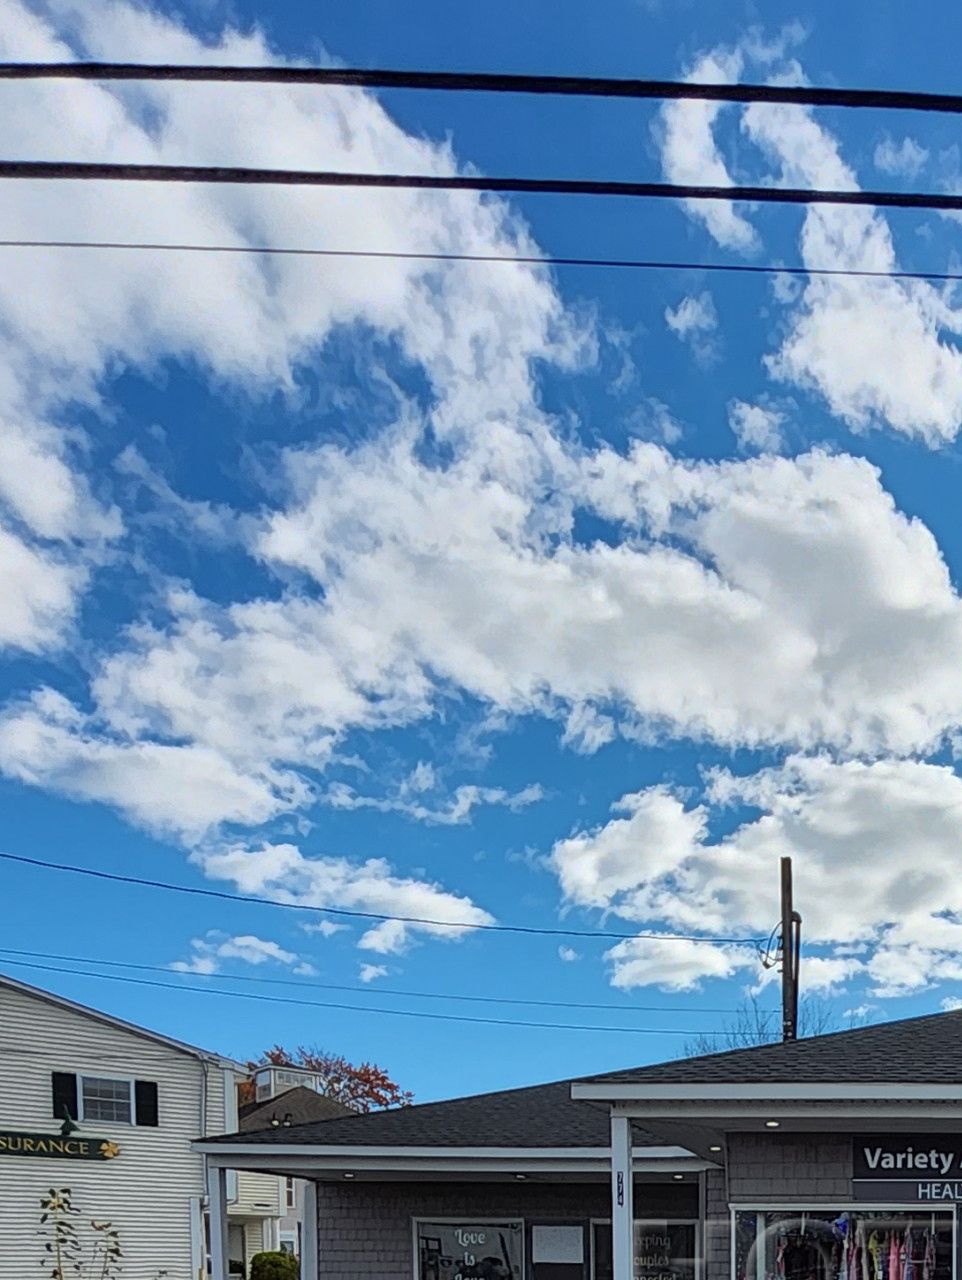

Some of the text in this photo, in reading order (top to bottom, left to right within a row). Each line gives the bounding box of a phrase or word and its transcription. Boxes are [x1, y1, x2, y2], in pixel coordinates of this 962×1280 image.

[864, 1147, 954, 1174] Variety
[455, 1229, 486, 1247] Love
[464, 1252, 475, 1266] is
[634, 1254, 669, 1269] ouples
